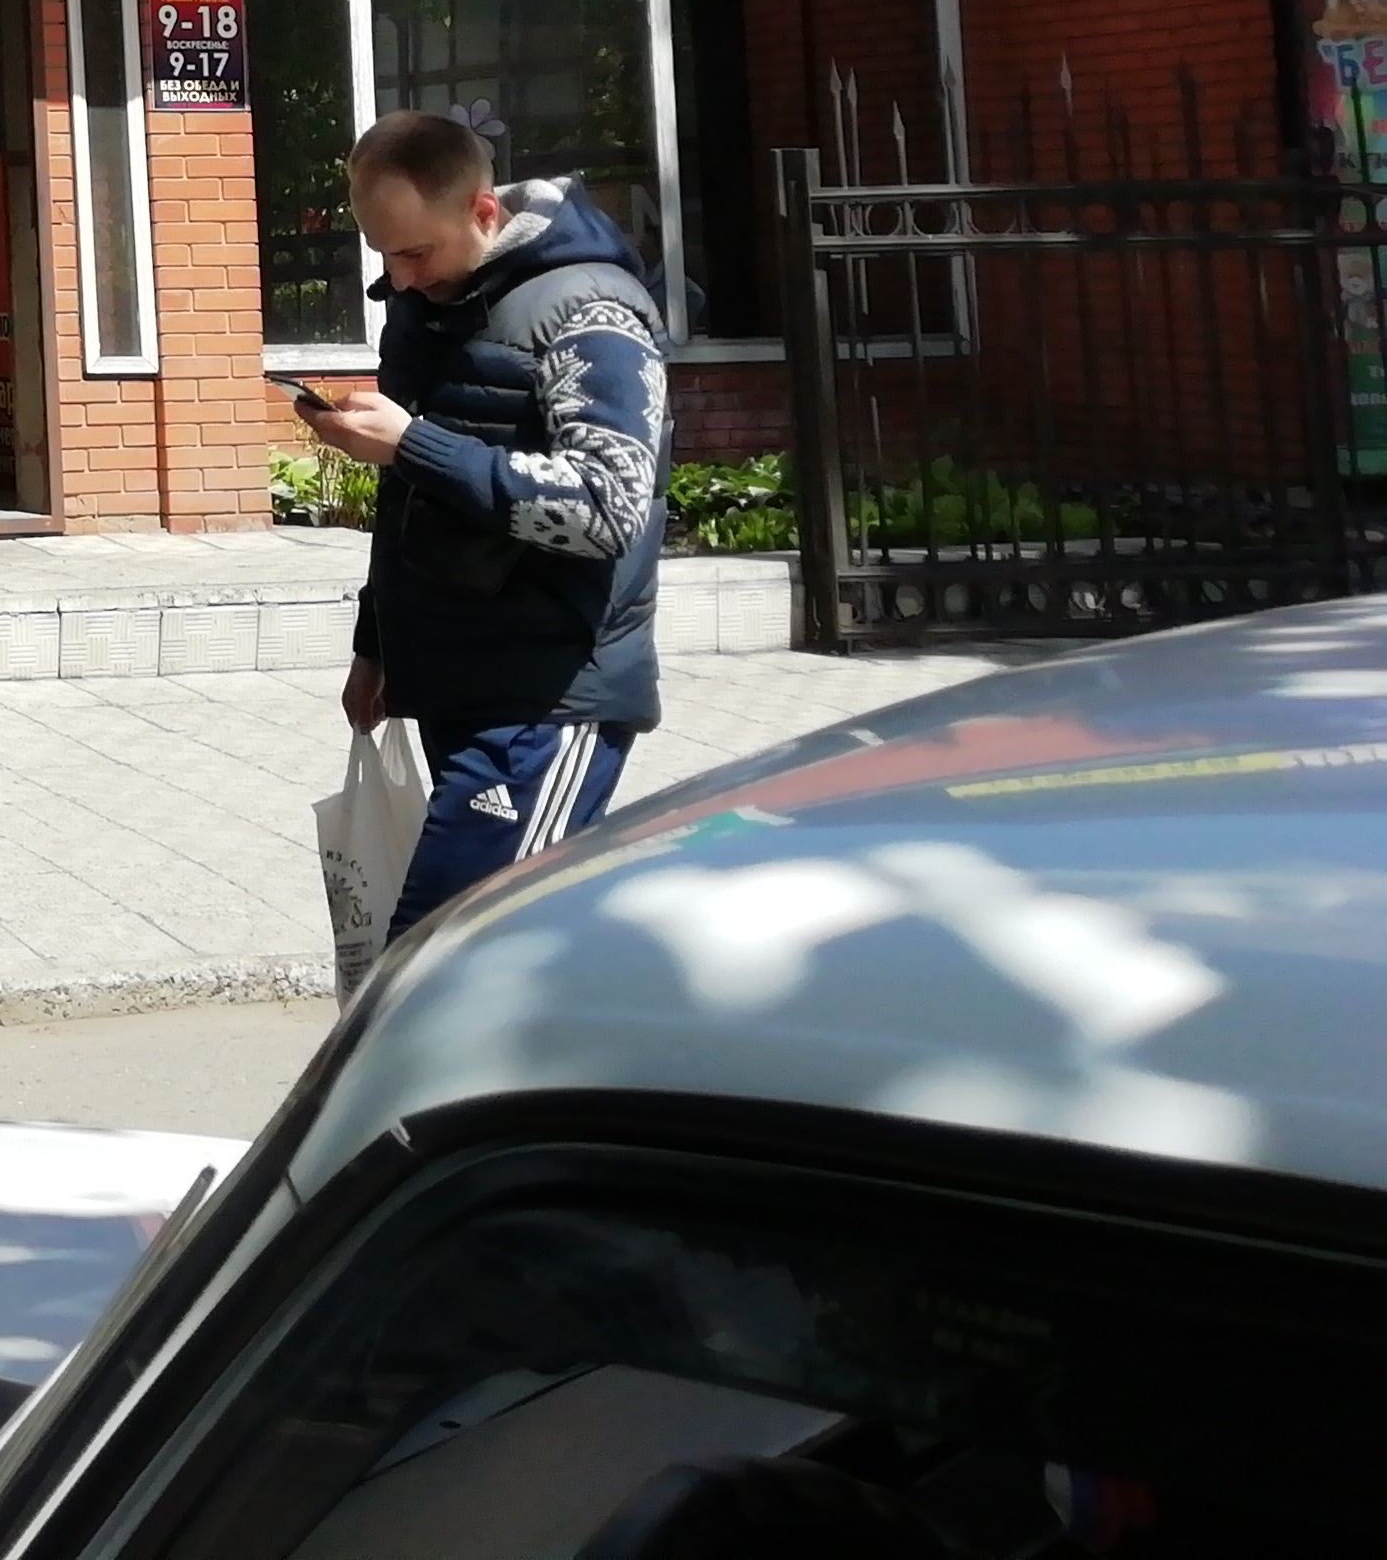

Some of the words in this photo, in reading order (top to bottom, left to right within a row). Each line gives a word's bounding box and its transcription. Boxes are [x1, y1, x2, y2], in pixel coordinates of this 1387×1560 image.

[158, 5, 238, 39] 9-18
[169, 52, 230, 77] 9-17
[160, 80, 181, 91] БЕЗ
[184, 80, 227, 91] ОБЕДА
[231, 80, 239, 90] И
[162, 91, 237, 103] ВЫХОДНЫХ
[469, 797, 518, 821] adidas
